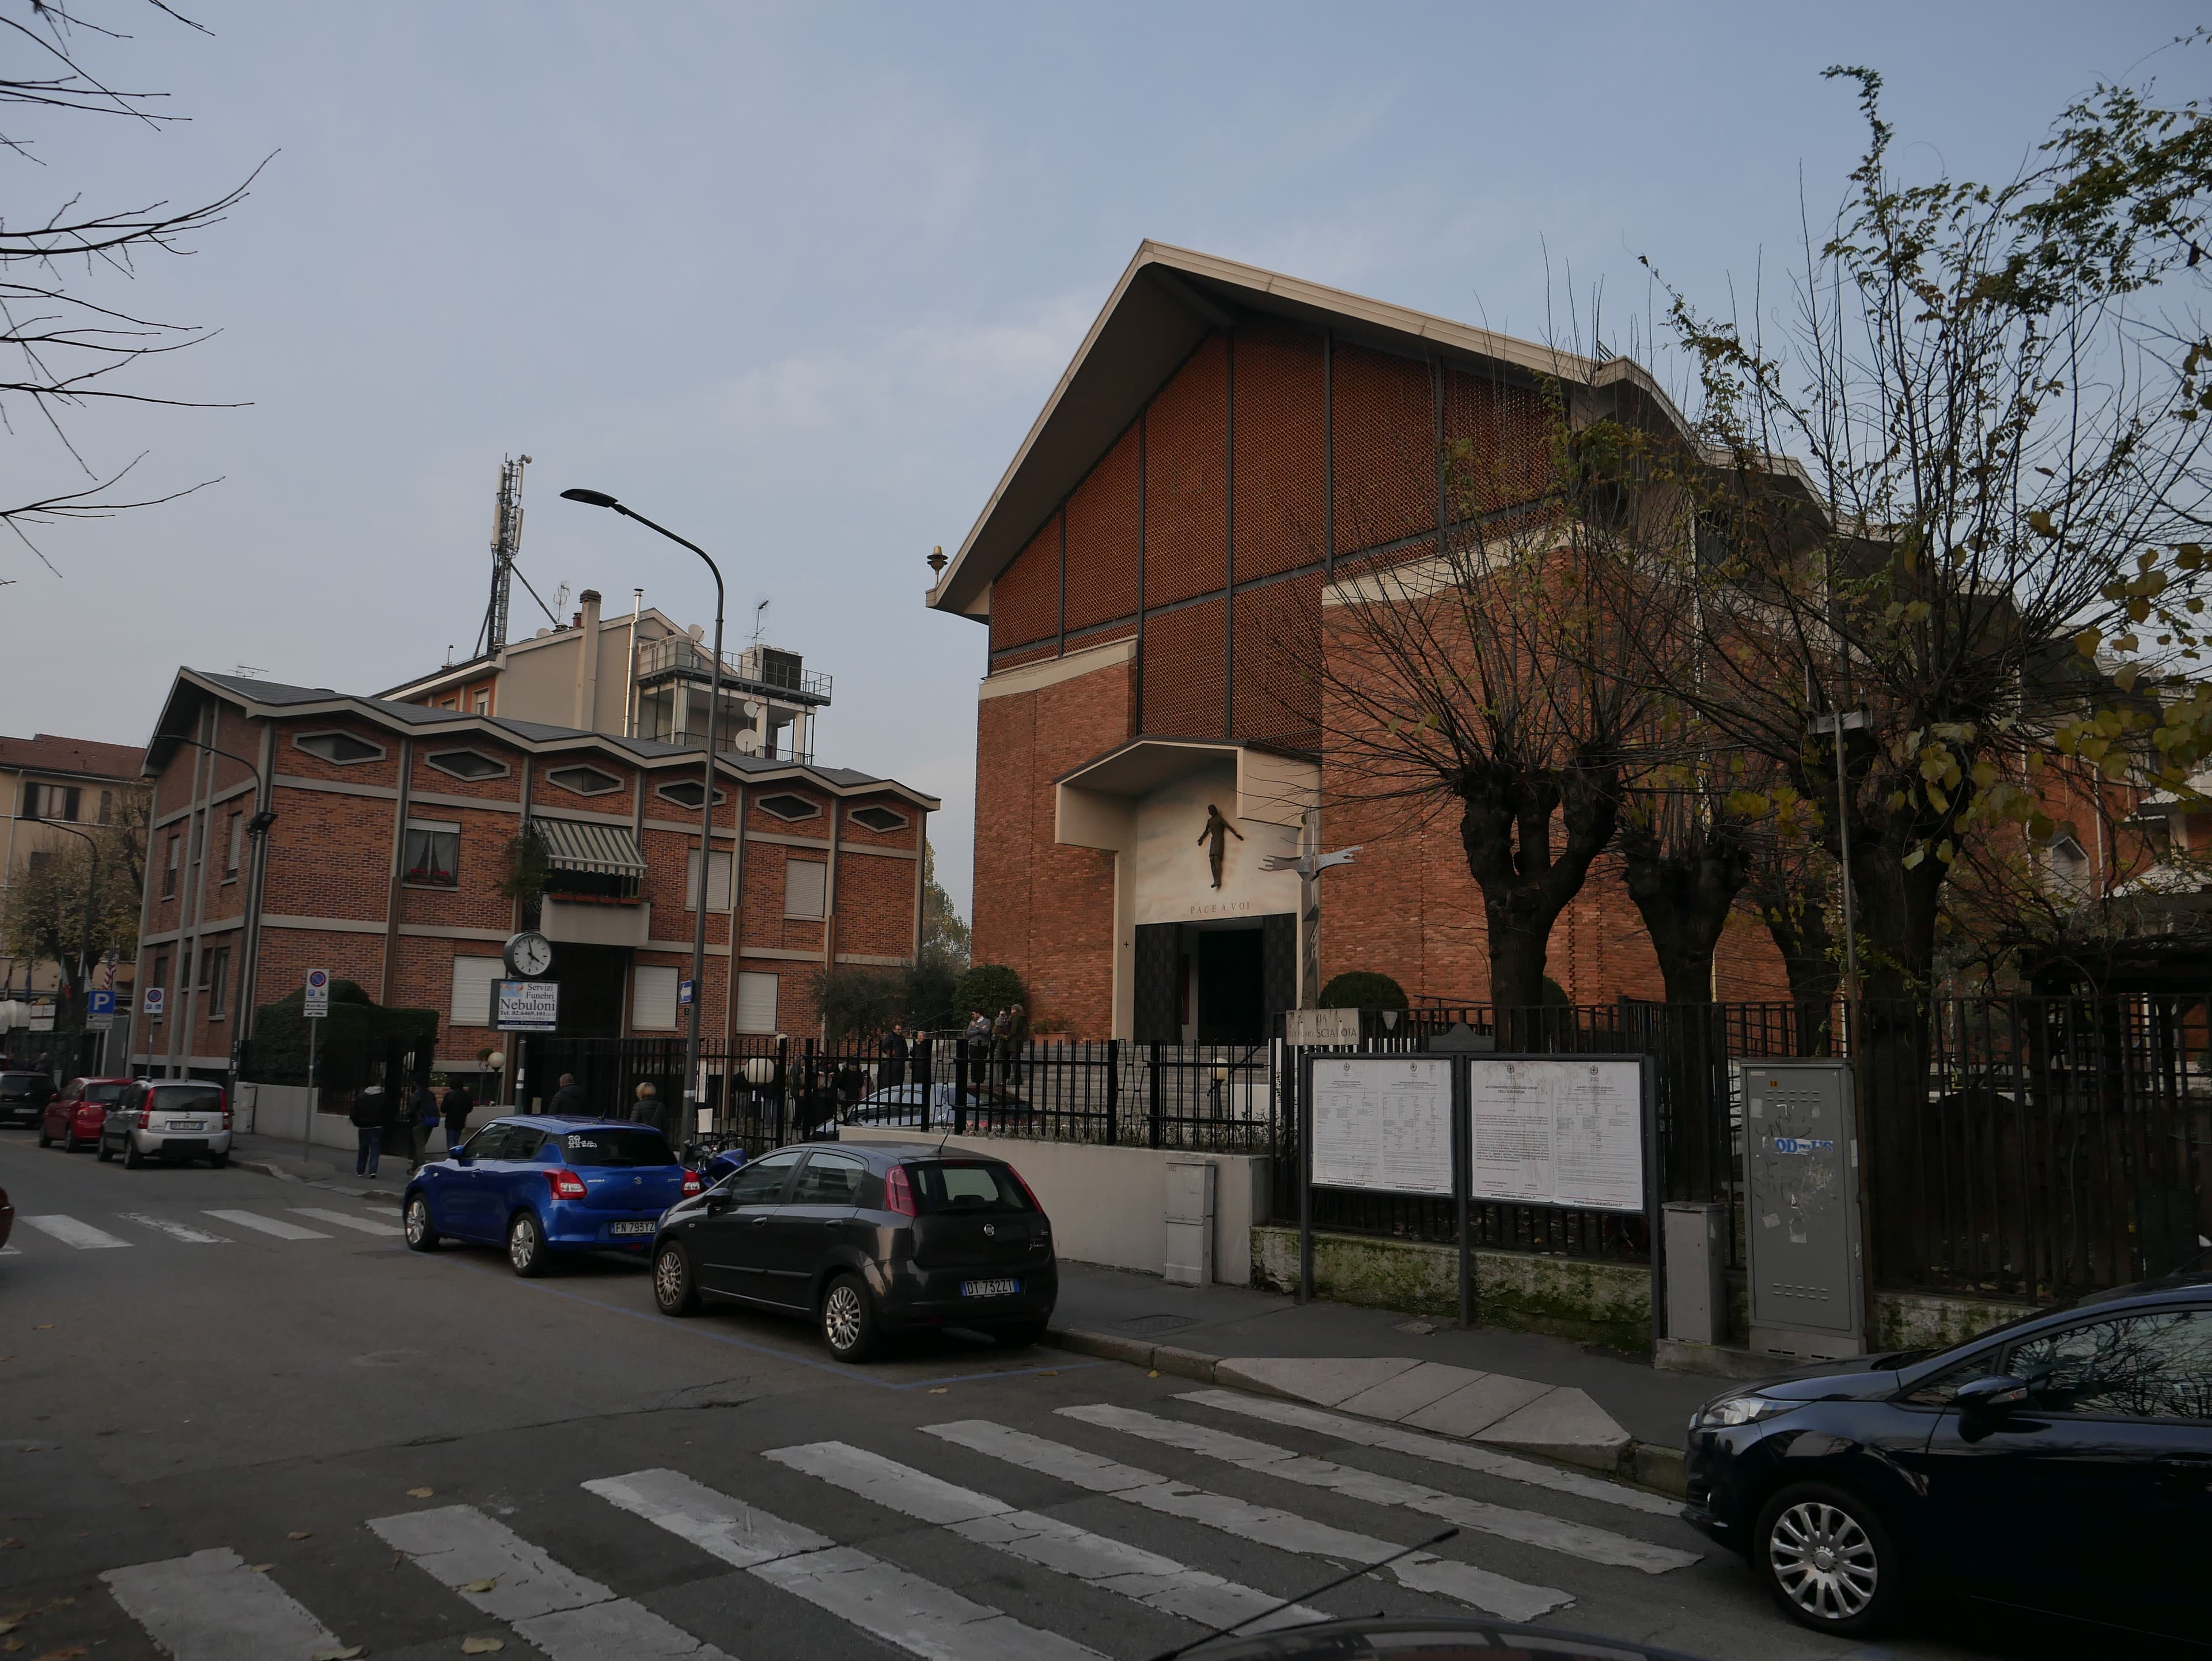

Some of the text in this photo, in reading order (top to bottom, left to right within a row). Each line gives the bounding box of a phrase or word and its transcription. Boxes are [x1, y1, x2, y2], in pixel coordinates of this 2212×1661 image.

[1191, 905, 1217, 914] PACE
[1231, 902, 1249, 910] VOI
[93, 993, 110, 1010] P
[526, 992, 554, 1000] Funebri
[500, 998, 555, 1011] Nebuloni
[1316, 1028, 1357, 1038] SCIALOIA
[616, 1222, 654, 1232] FN 793YZ
[967, 1279, 1013, 1294] DT 732ZT
